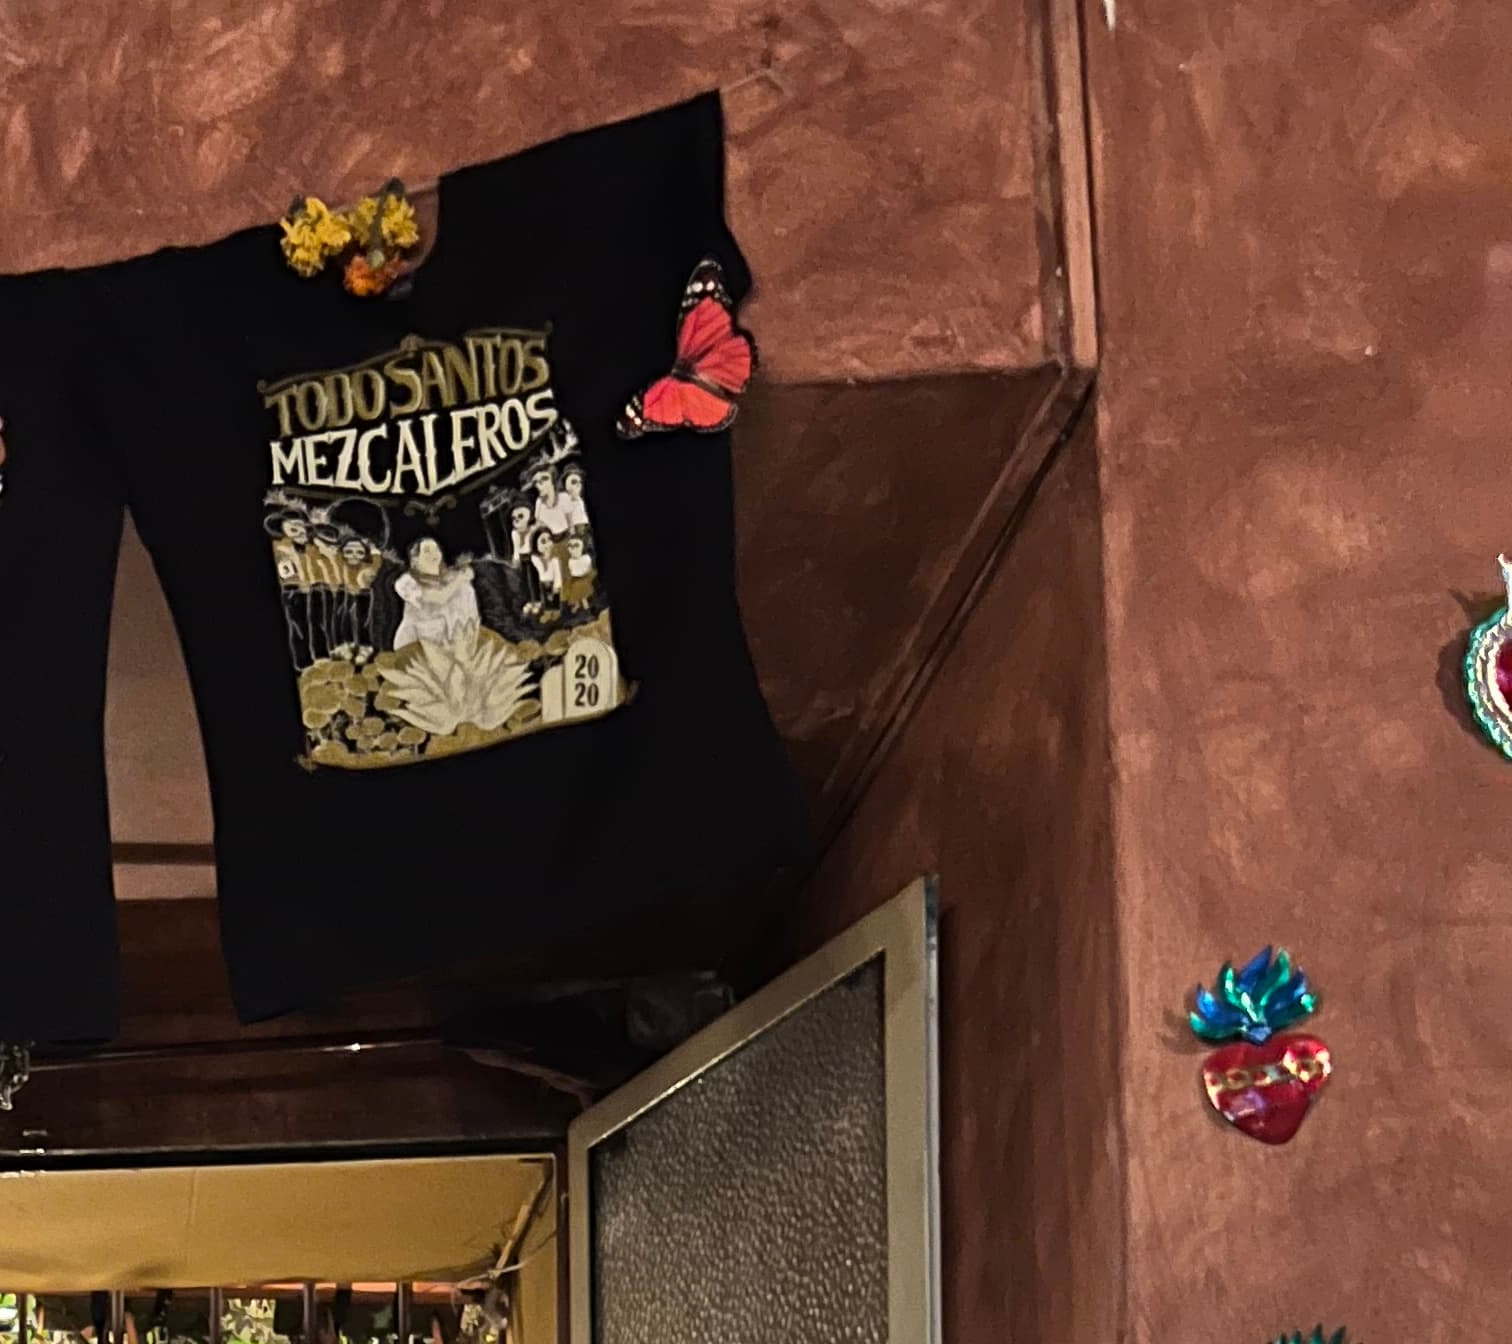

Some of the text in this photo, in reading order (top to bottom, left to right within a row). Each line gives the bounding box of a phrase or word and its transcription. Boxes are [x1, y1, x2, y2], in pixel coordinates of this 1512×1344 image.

[385, 334, 550, 419] SANTOS
[269, 389, 559, 496] MEZCALEROS
[574, 654, 599, 680] 20
[574, 682, 599, 708] 20
